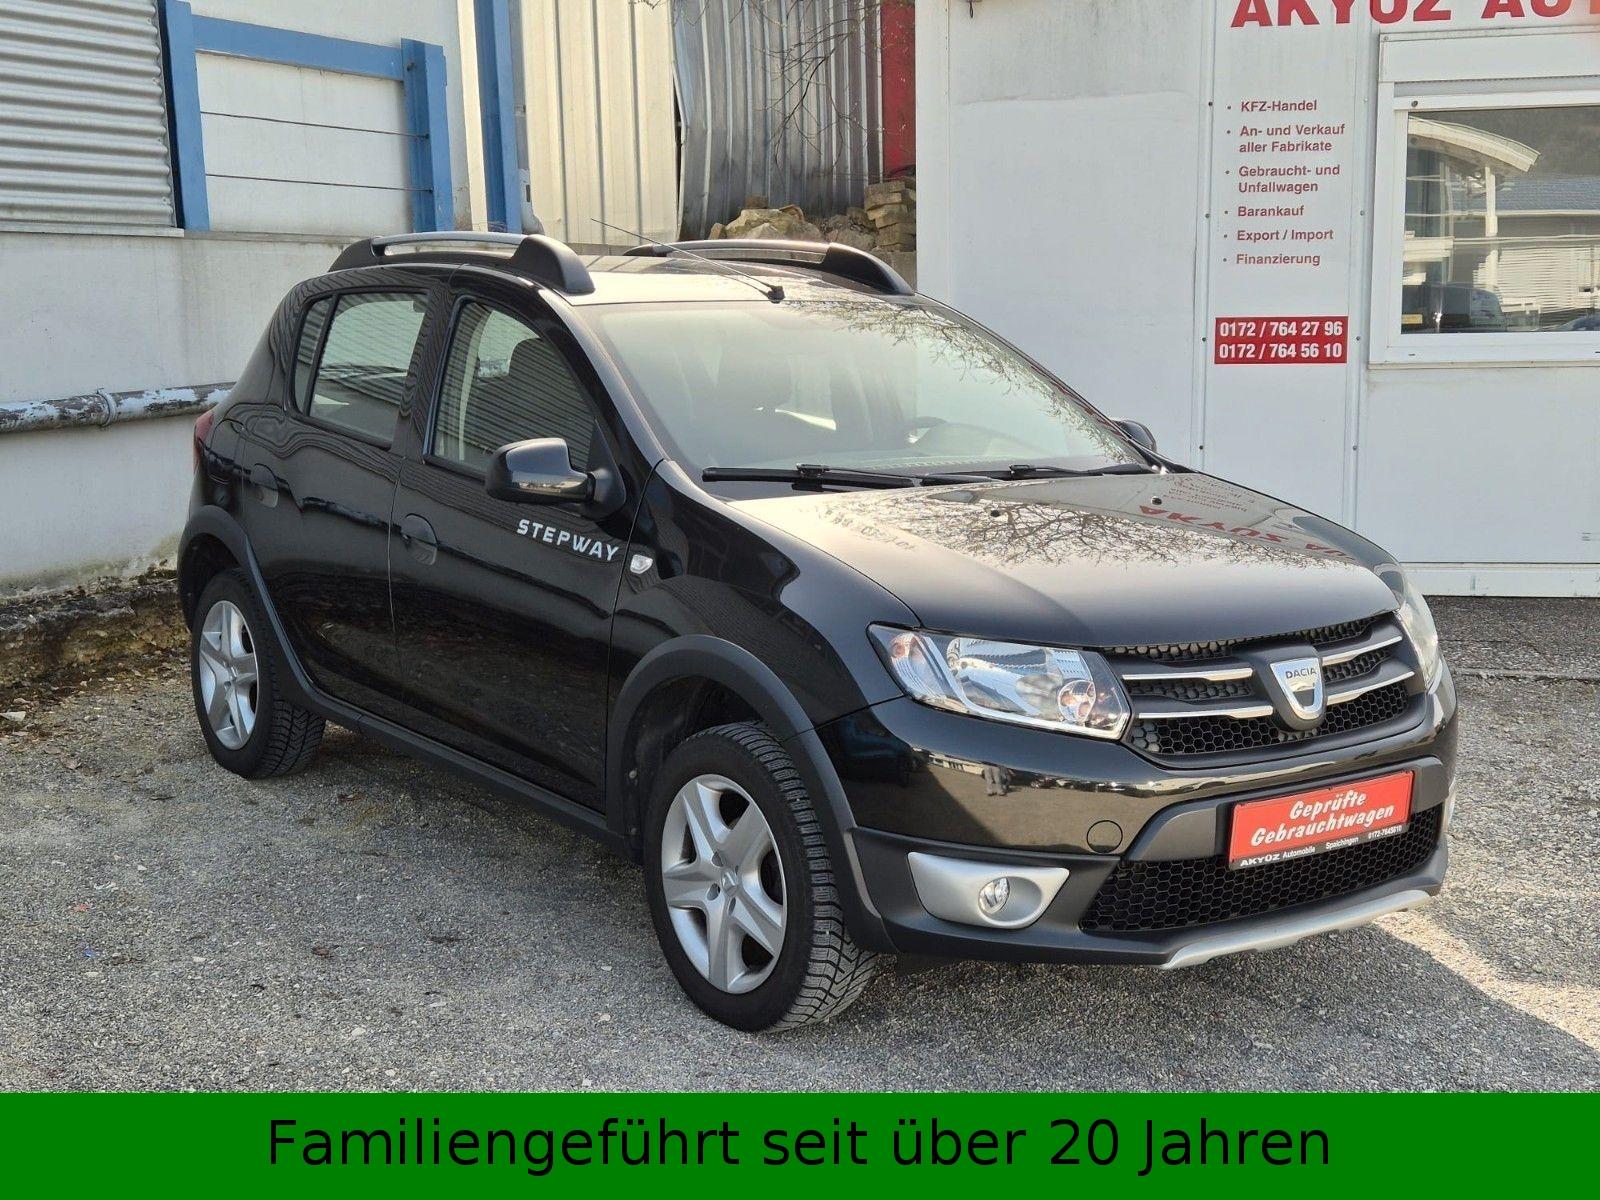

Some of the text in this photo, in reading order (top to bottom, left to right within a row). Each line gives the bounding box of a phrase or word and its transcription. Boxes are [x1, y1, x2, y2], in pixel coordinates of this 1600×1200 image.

[1240, 99, 1318, 112] KFZ-Handel
[1239, 123, 1345, 137] An- und Verkauf
[1239, 140, 1333, 153] aller Fabrikate
[1238, 164, 1340, 177] Gebraucht- und
[1238, 181, 1318, 195] Unfallwagen
[1237, 204, 1305, 217] Barankauf
[1237, 229, 1280, 243] Export
[1291, 229, 1335, 243] Import
[1236, 253, 1321, 267] Finanzierung
[1219, 321, 1343, 338] 0172 / 764 27 96
[1219, 343, 1343, 360] 0172 / 764 56 10
[516, 518, 620, 561] STEPWAY
[1285, 667, 1318, 679] DACIA
[1289, 789, 1367, 821] Geprüfte
[1250, 804, 1395, 847] Gebrauchtwagen
[1282, 845, 1316, 859] Automobile
